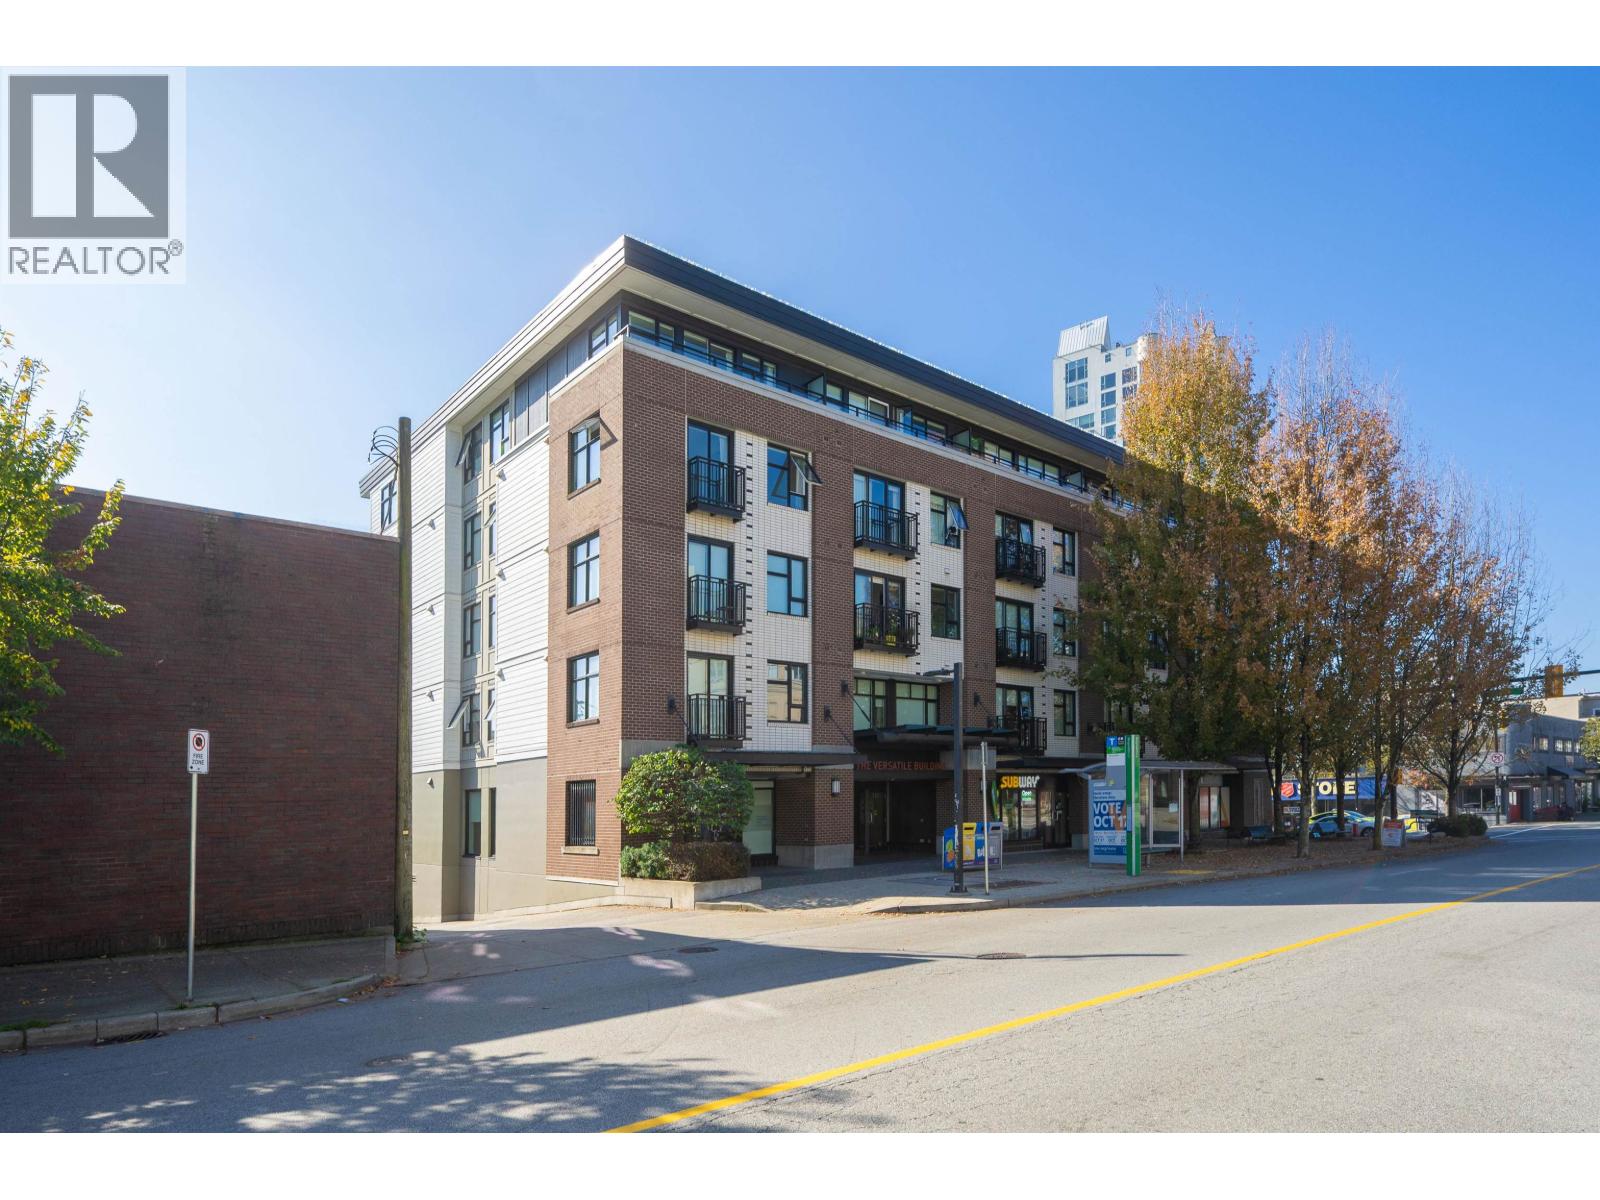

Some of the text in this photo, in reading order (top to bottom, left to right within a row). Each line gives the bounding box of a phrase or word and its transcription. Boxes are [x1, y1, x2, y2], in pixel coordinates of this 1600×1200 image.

[873, 760, 912, 770] VERSATILE
[1000, 775, 1039, 789] SUBWAY
[1094, 802, 1121, 814] VOTE
[1094, 816, 1115, 827] OCT
